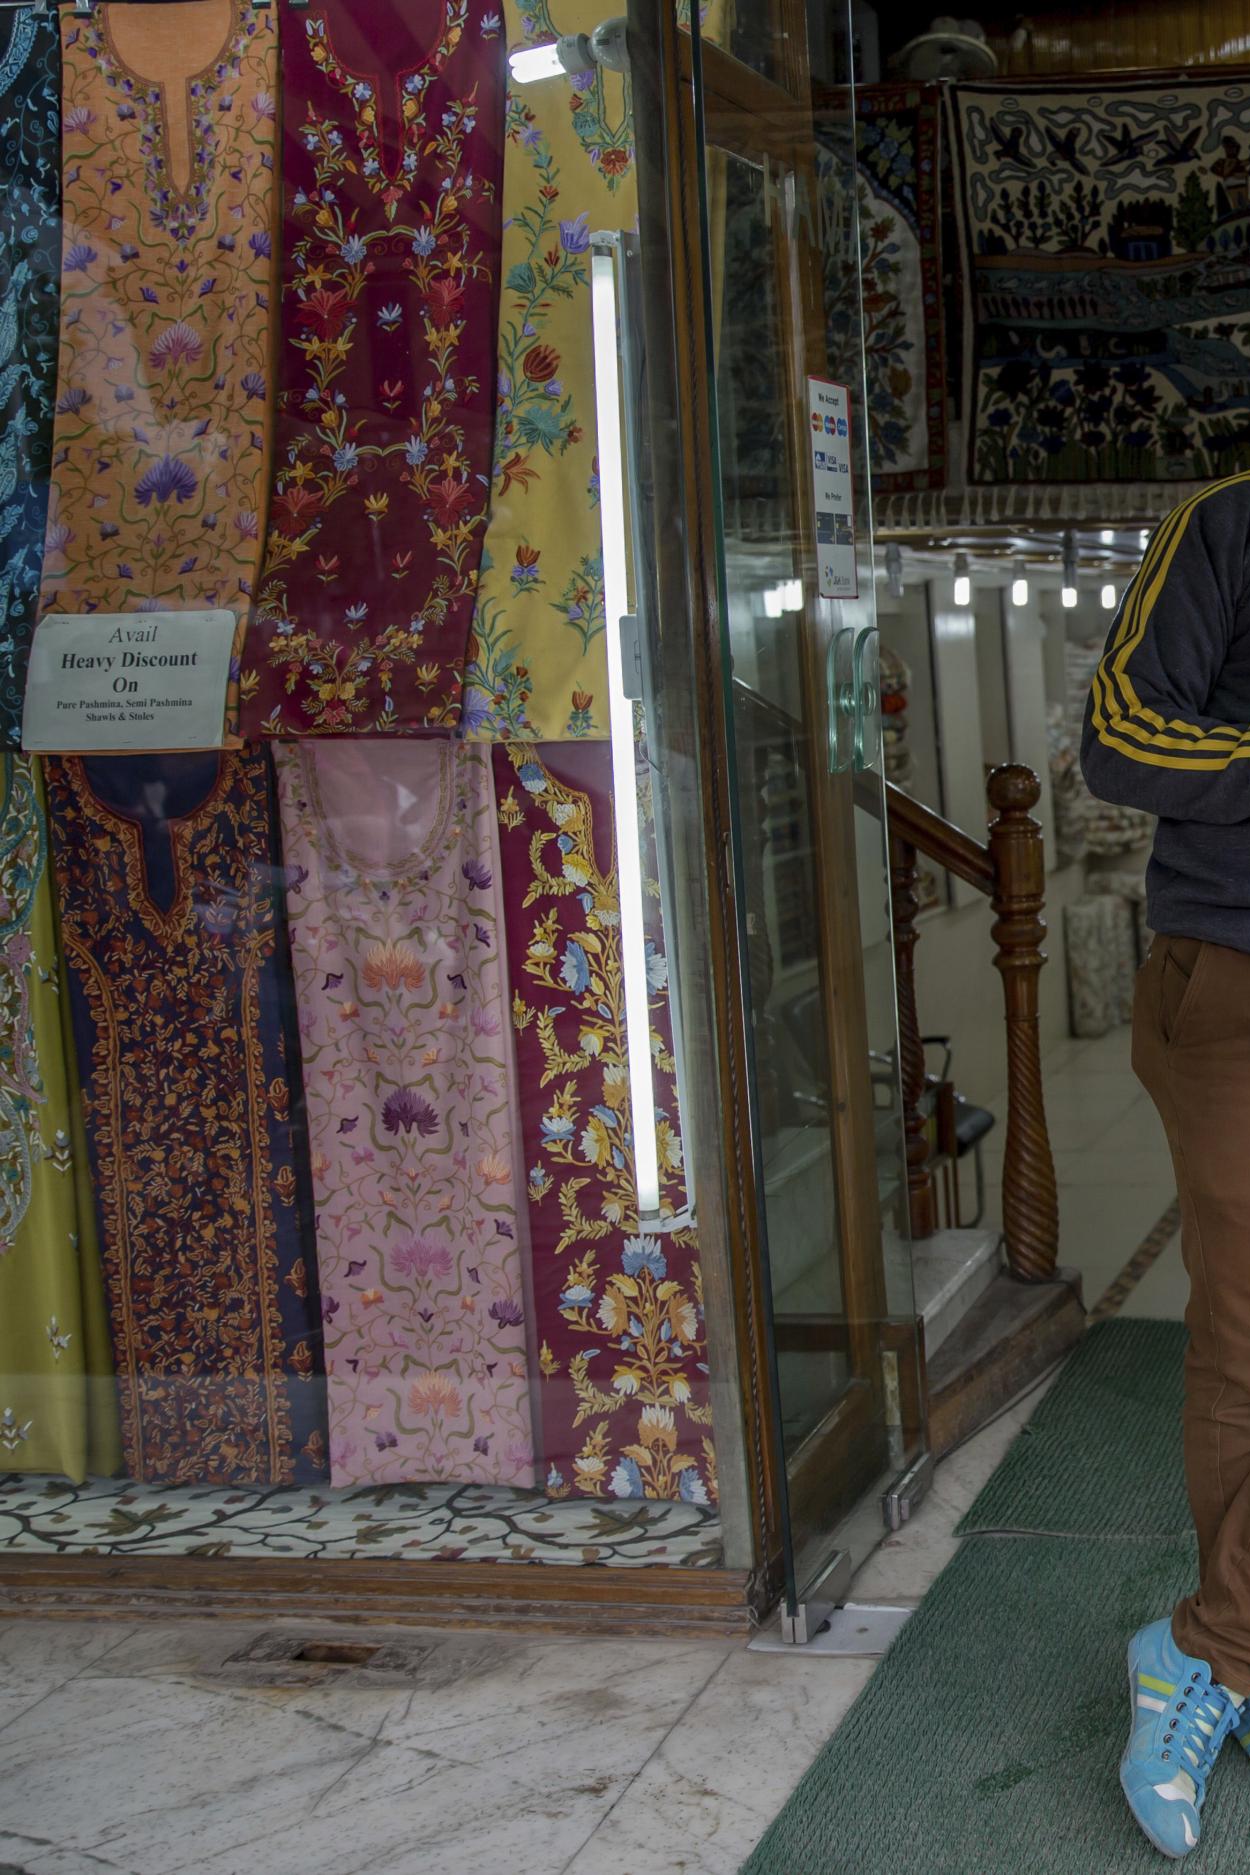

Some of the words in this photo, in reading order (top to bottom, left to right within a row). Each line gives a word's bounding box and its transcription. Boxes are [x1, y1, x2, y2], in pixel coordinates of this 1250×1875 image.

[838, 463, 849, 473] VISA
[108, 626, 158, 643] Avail
[61, 653, 117, 672] Heavy
[121, 651, 198, 667] Discount
[112, 676, 138, 693] On
[56, 701, 77, 710] Pure
[79, 700, 124, 709] Pashmina,
[125, 699, 147, 708] Semi
[149, 698, 193, 707] Pashmina
[86, 712, 117, 722] Shawls
[118, 713, 126, 721] &
[128, 712, 154, 721] Stoles
